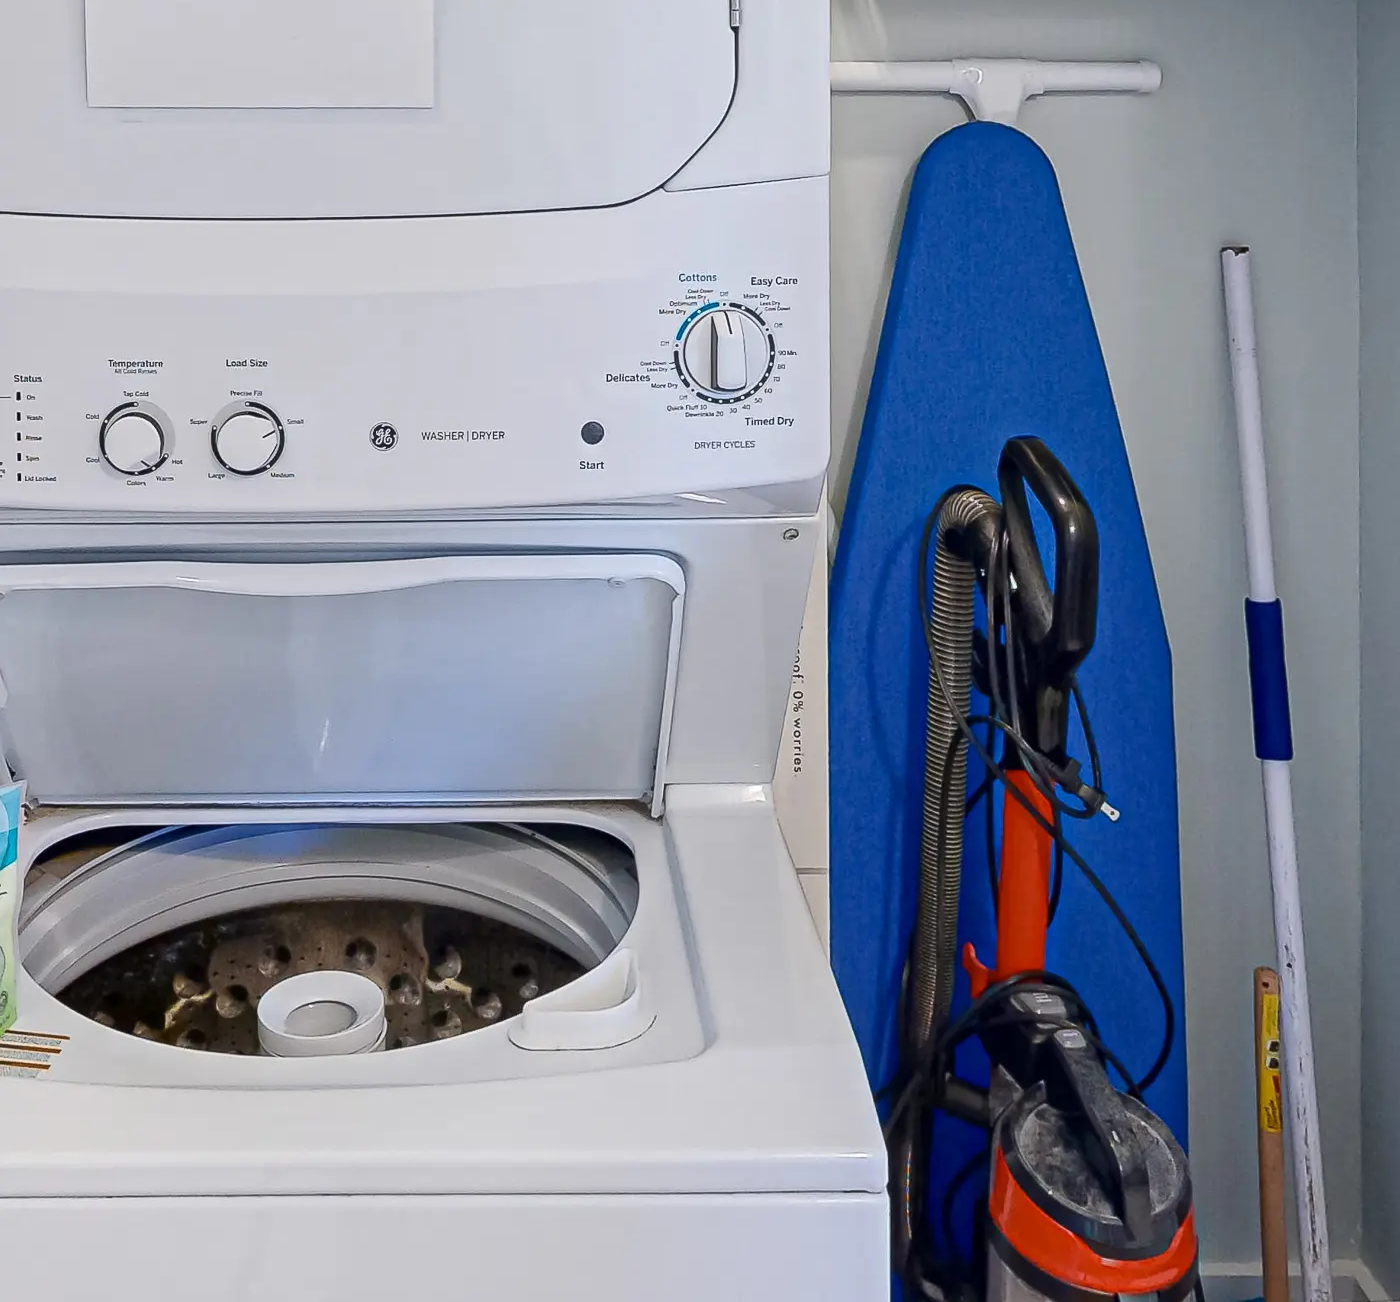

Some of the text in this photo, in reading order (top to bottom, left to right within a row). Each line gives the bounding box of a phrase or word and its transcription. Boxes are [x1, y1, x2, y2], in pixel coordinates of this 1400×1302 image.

[679, 273, 717, 282] Cottons
[750, 276, 798, 287] Easy Care
[108, 359, 164, 369] Temperature
[226, 359, 268, 367] Load Size
[14, 374, 42, 383] Status
[606, 373, 651, 382] Delicates
[745, 417, 795, 427] Timed Dry
[421, 431, 505, 441] WASHER DRYER
[694, 440, 756, 449] DRYER CYCLES
[579, 461, 605, 470] Start
[793, 691, 804, 713] 0%
[793, 718, 804, 777] worries.
